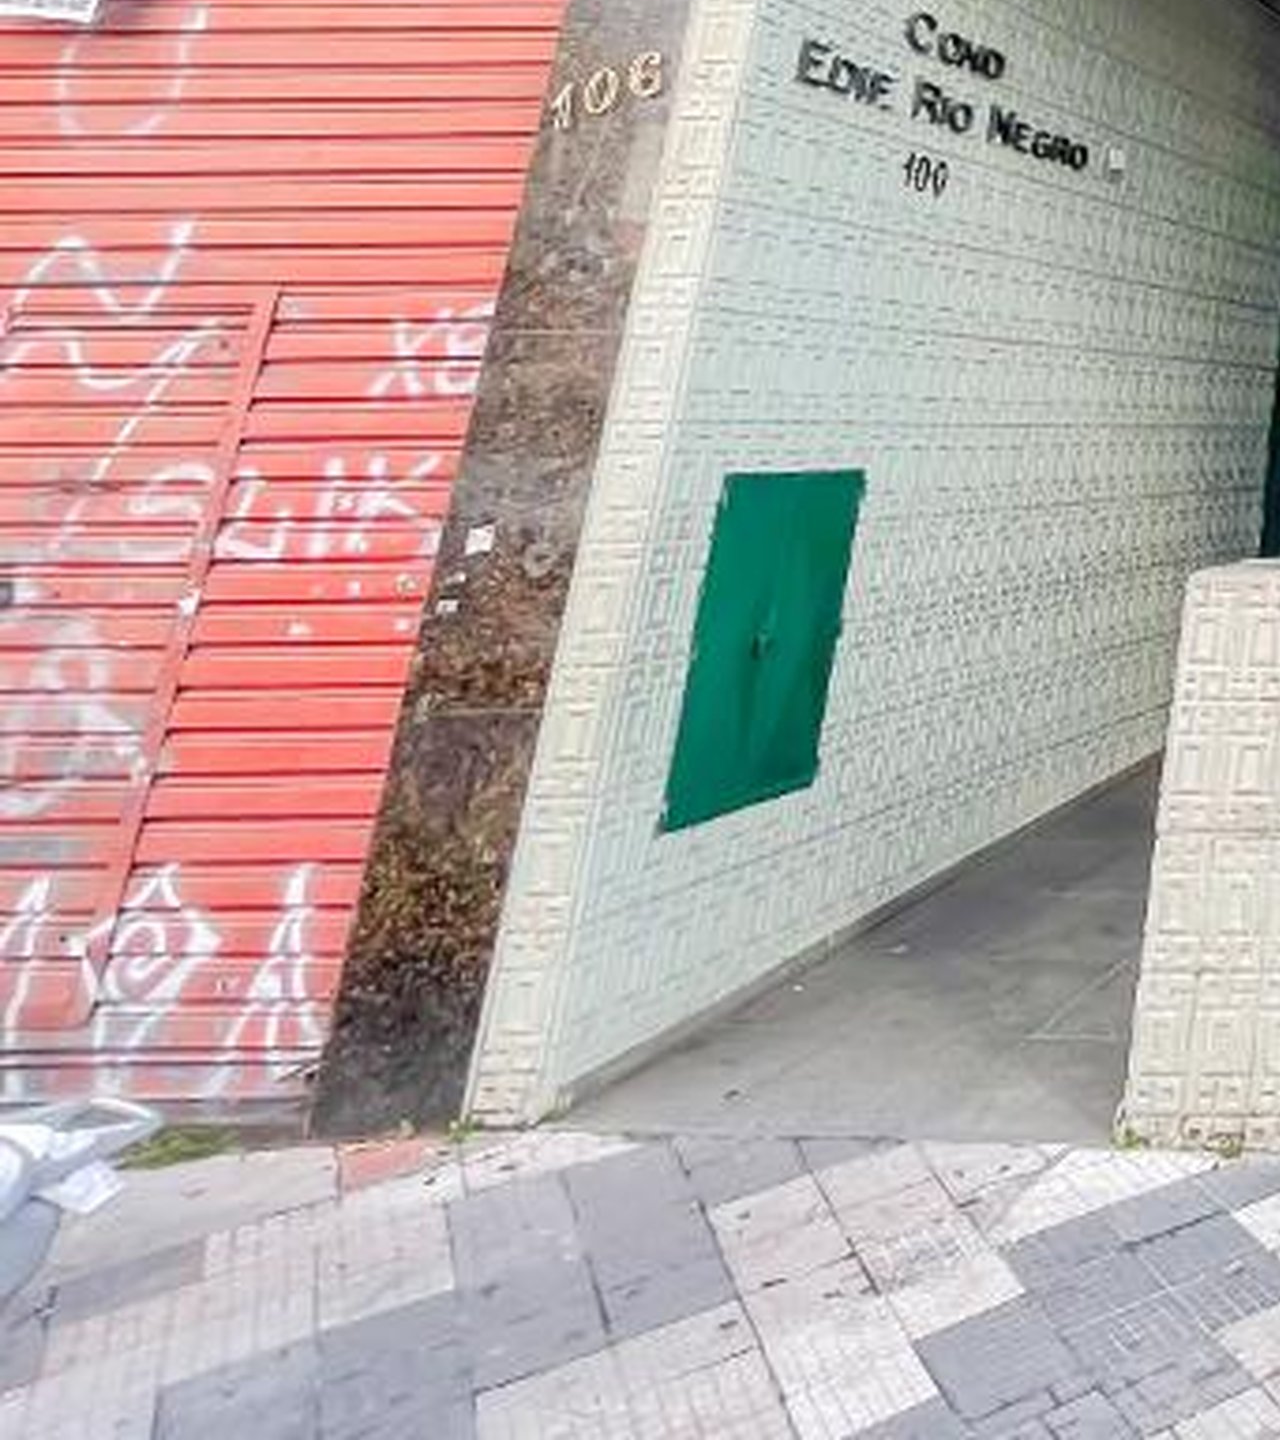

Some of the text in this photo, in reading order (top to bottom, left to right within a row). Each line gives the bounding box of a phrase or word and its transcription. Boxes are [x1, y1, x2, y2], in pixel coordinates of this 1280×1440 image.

[551, 51, 662, 130] 106
[985, 103, 1090, 172] NEGRO
[902, 151, 949, 198] 100
